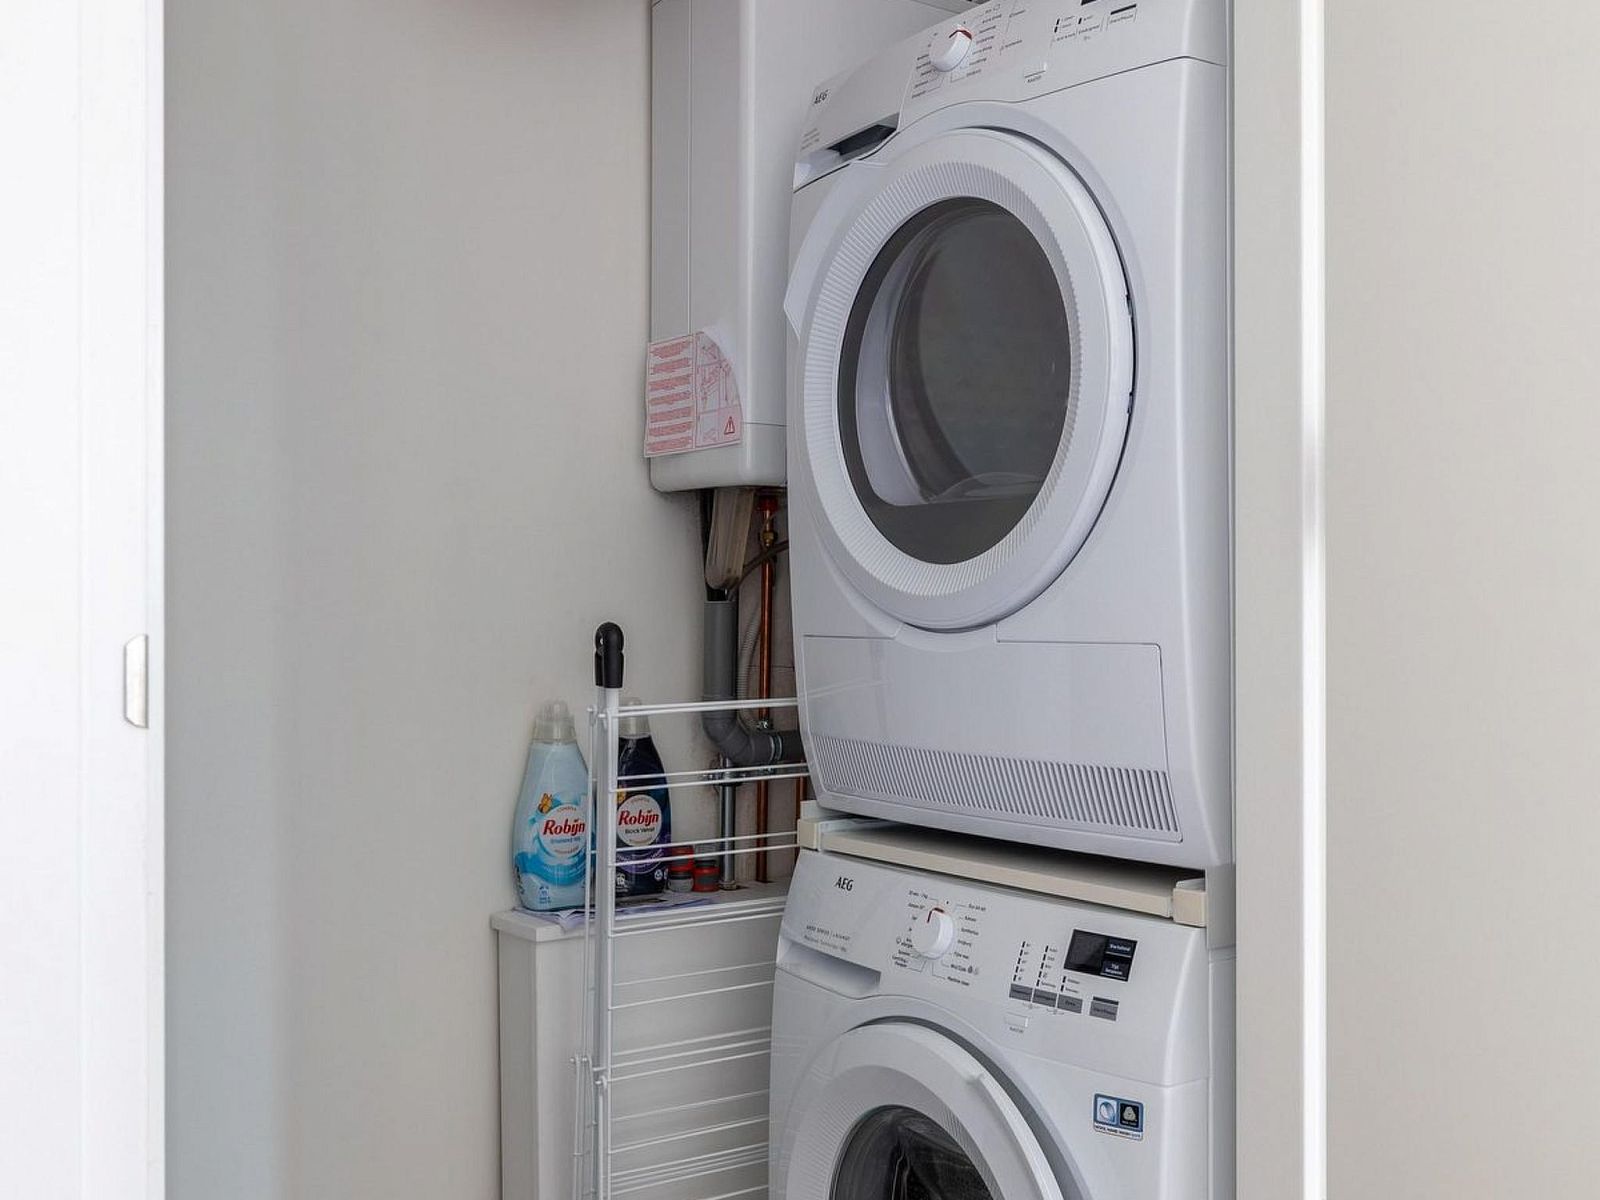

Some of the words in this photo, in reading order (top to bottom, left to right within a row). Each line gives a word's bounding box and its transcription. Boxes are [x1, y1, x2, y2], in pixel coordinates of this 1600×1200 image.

[618, 809, 659, 827] Robijn
[543, 818, 586, 837] Robijn
[834, 876, 854, 891] AEG
